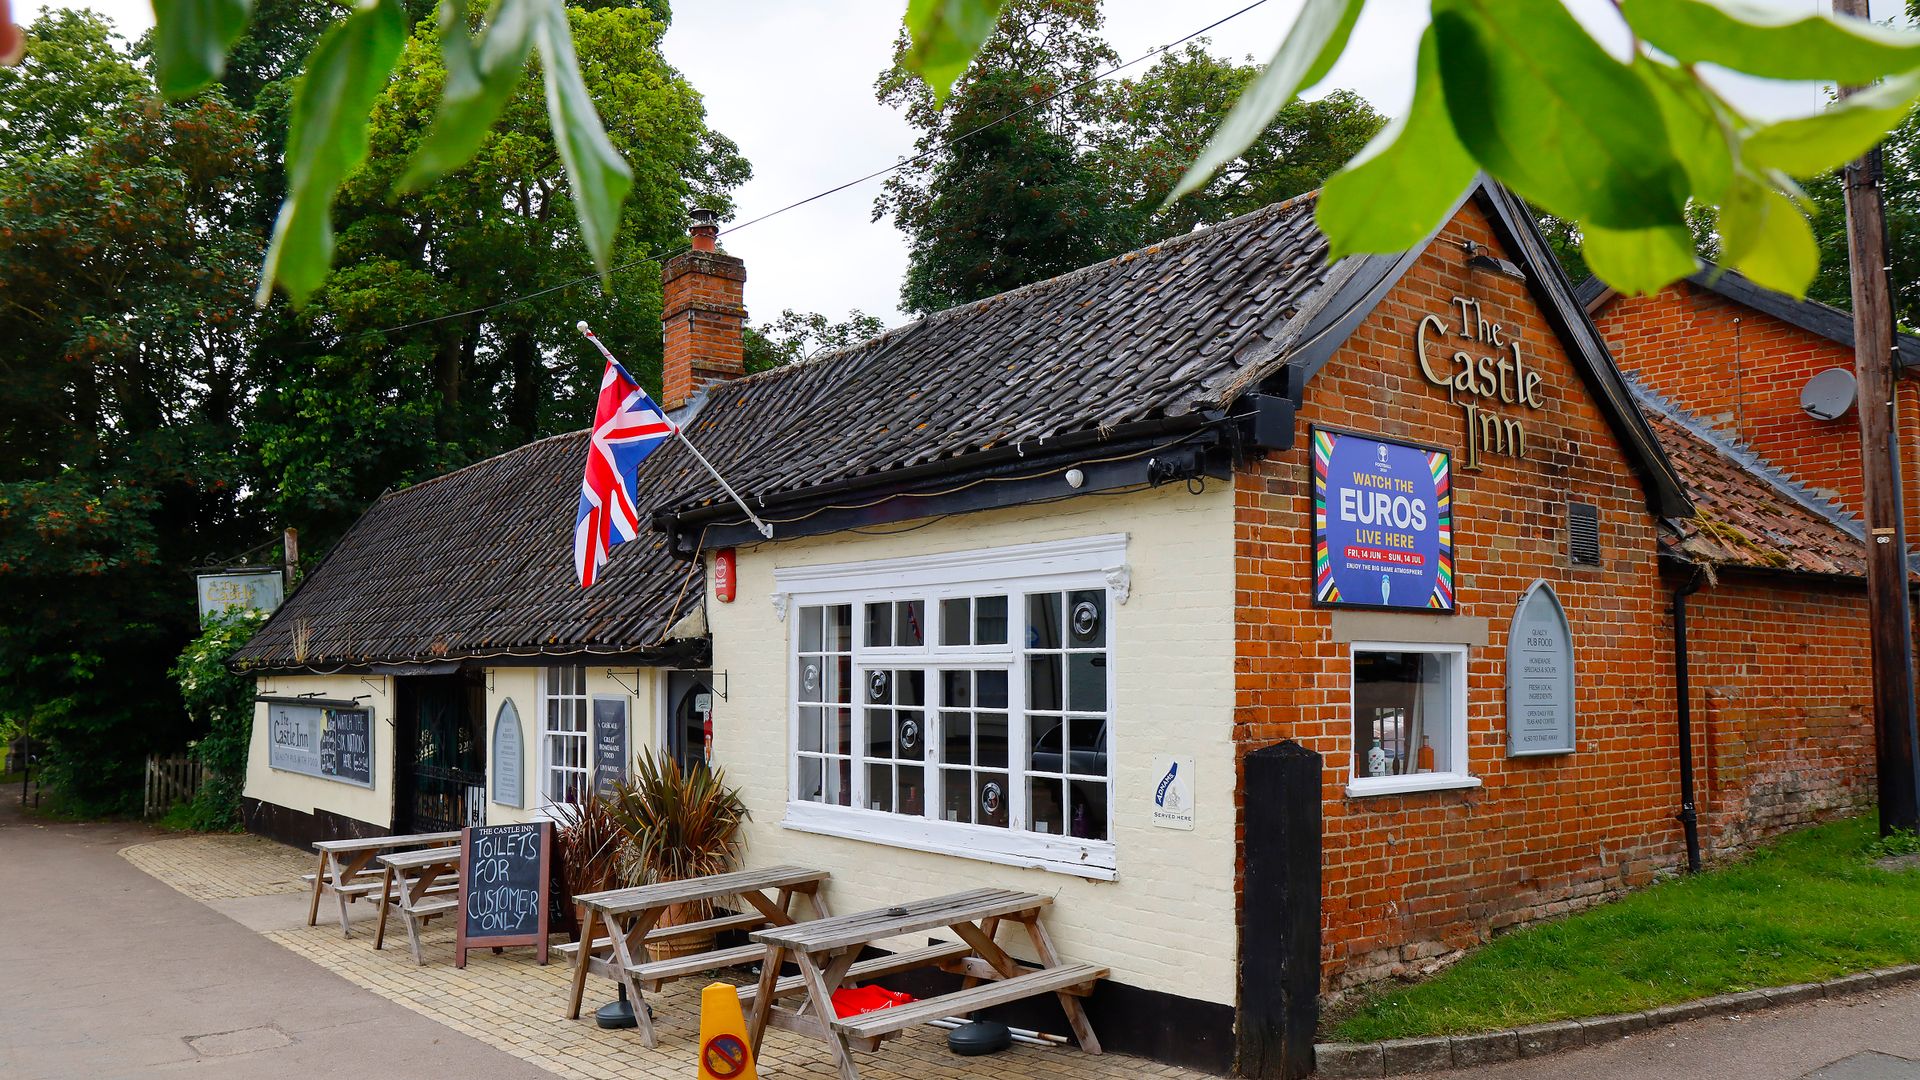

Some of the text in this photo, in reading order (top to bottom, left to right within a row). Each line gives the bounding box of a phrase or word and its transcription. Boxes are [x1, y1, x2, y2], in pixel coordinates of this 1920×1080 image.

[1452, 296, 1504, 347] The
[1417, 314, 1544, 409] Castle
[1457, 401, 1527, 471] Inn
[1353, 471, 1414, 493] WATCH THE
[1340, 487, 1427, 531] EUROS
[1356, 528, 1415, 549] LIVE HERE
[1347, 548, 1360, 558] FRI,
[1361, 550, 1368, 558] 14
[1369, 551, 1382, 559] JUN
[1388, 553, 1403, 562] SUN,
[1411, 556, 1422, 564] JUL
[1346, 562, 1361, 570] ENJOY
[1394, 567, 1423, 576] ATMOSPHERE
[1527, 637, 1553, 648] PUB FOOD
[1529, 692, 1552, 700] INGREDIENTS
[280, 711, 288, 726] The
[336, 714, 364, 731] WATCH THE
[274, 719, 295, 748] Castle
[295, 722, 309, 748] Inn
[337, 733, 366, 754] SIX NATIONS
[603, 736, 615, 744] GREAT
[599, 743, 620, 752] HOMEMADE
[607, 765, 619, 773] MUSIC
[1156, 773, 1174, 803] ADNAMS
[1154, 812, 1176, 820] SERVED
[479, 828, 492, 836] THE
[493, 826, 520, 835] CASTLE
[474, 832, 540, 860] TOILETS
[474, 858, 510, 888] FOR
[467, 884, 539, 919] CUSTOMER
[481, 911, 527, 931] ONLY
